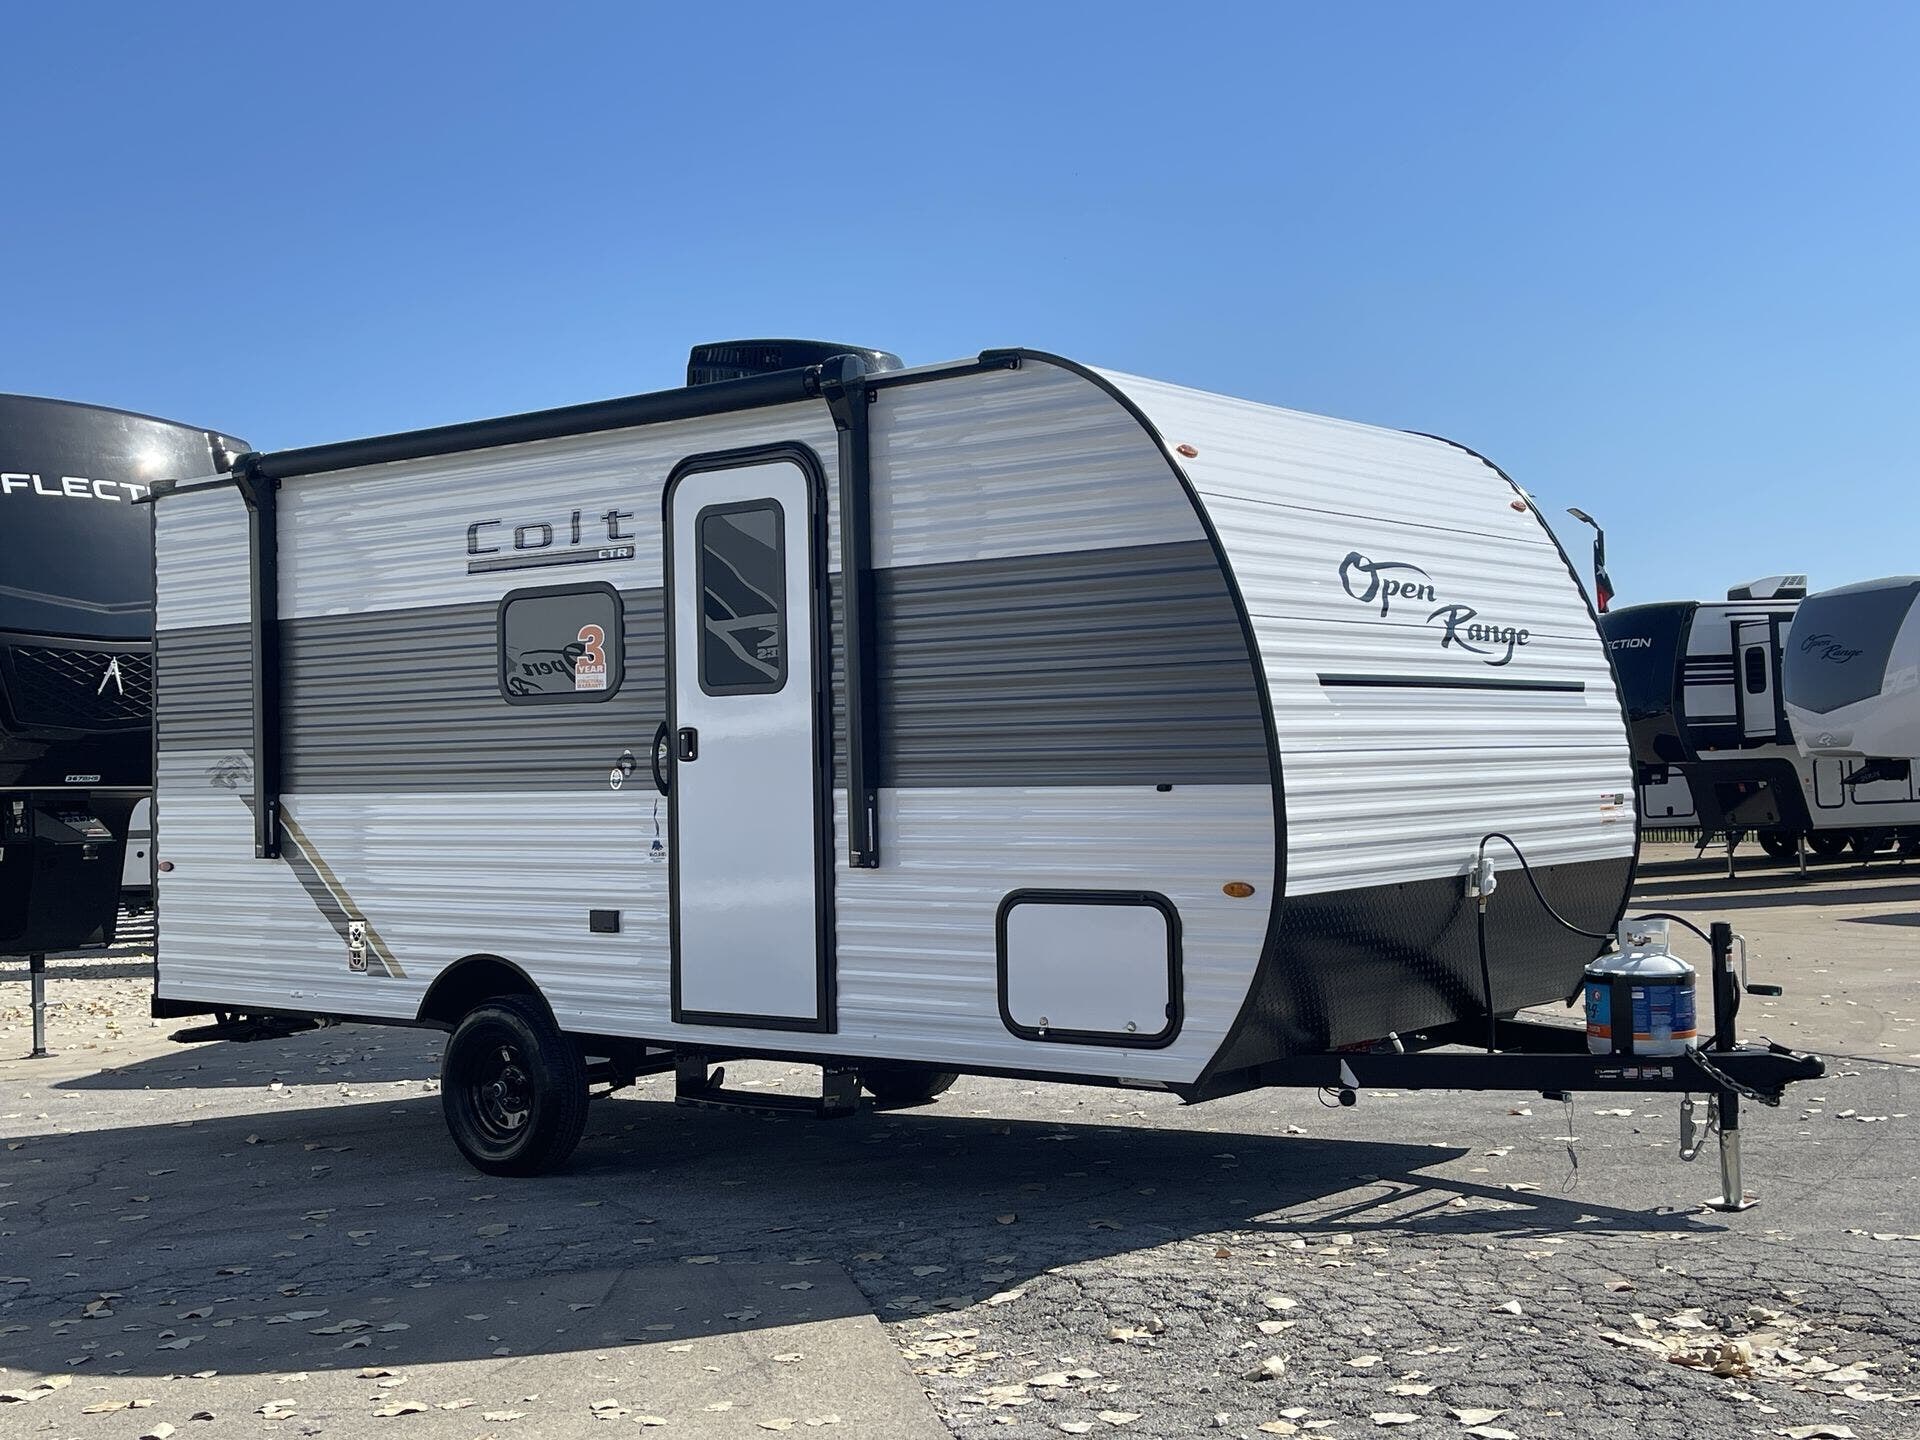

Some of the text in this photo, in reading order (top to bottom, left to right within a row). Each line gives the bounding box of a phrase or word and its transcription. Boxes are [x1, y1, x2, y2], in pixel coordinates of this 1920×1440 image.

[467, 509, 636, 554] Colt
[598, 546, 630, 559] CTR
[1338, 551, 1437, 617] Open
[578, 624, 606, 665] 3
[1426, 604, 1531, 667] Range
[1801, 634, 1835, 655] Open
[578, 664, 604, 674] YEAR
[1820, 644, 1864, 664] Range
